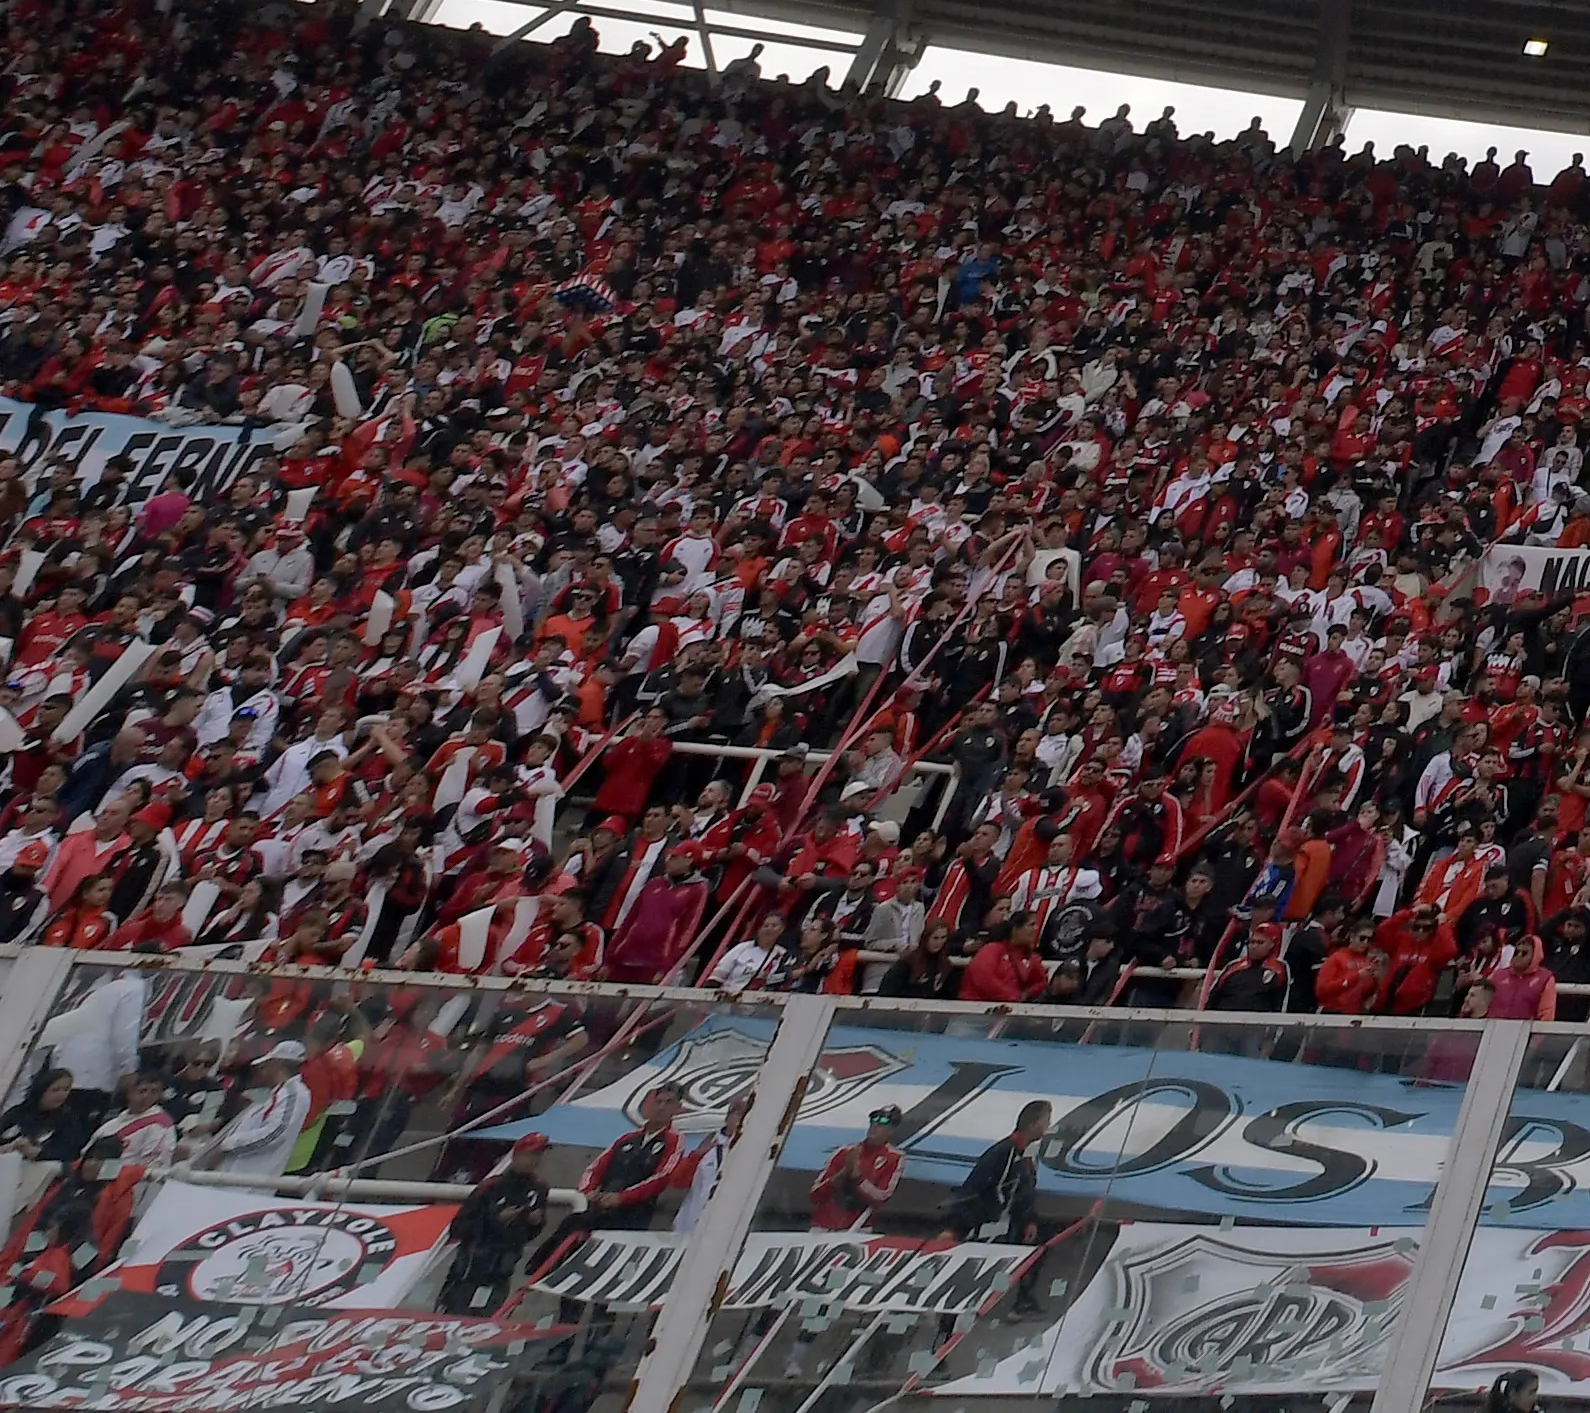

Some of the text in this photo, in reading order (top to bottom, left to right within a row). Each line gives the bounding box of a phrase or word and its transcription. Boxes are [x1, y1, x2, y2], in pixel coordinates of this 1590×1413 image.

[892, 1058, 1427, 1203] LOS
[198, 1209, 398, 1255] CLAYPOLE
[126, 1310, 250, 1359] NO
